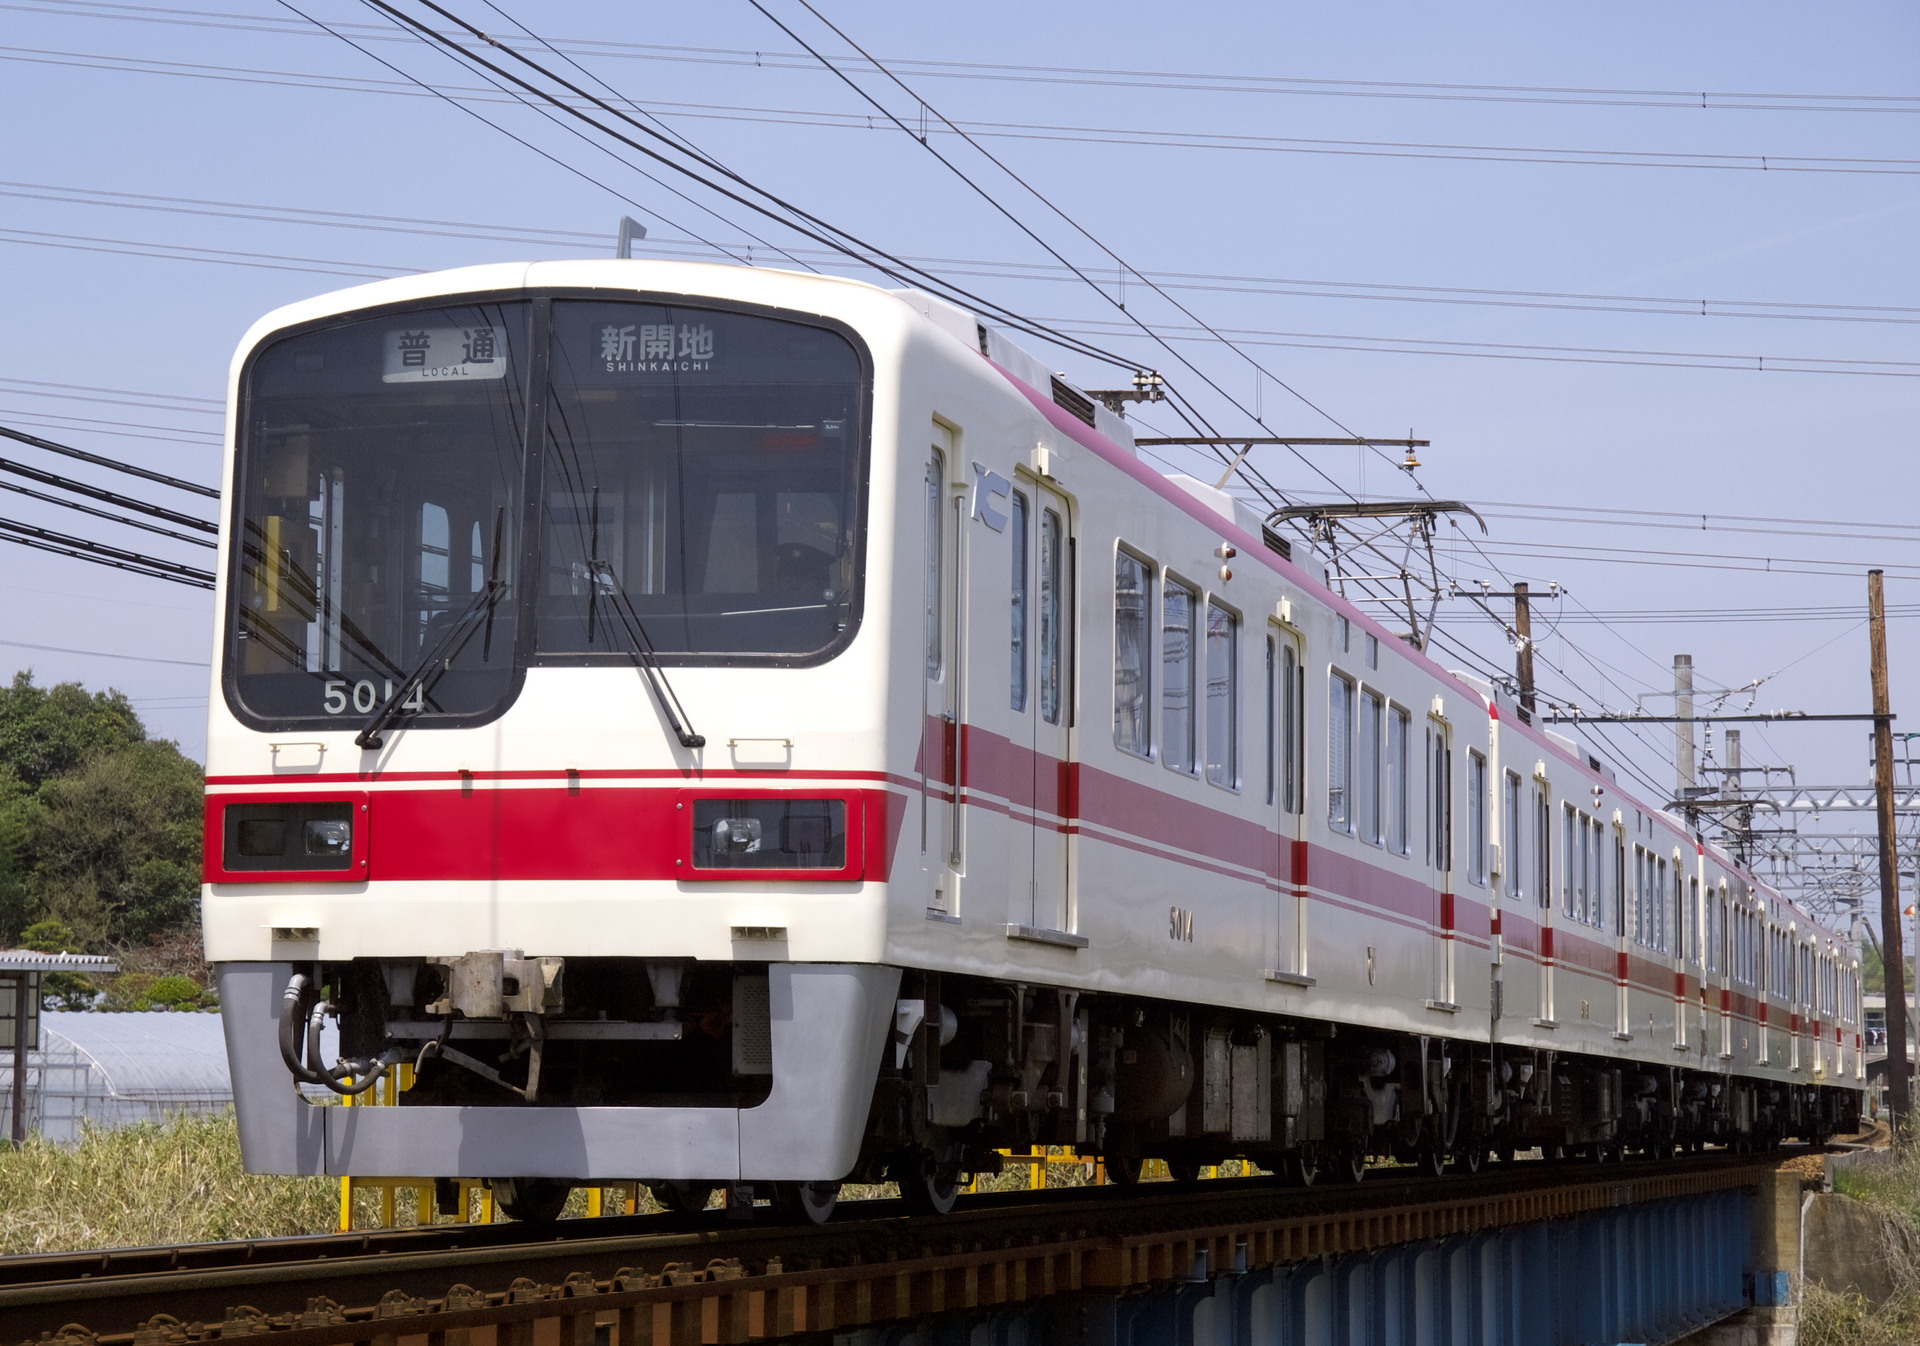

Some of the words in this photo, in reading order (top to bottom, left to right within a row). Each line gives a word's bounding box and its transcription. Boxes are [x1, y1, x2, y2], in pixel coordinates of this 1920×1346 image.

[398, 328, 495, 366] 普通
[600, 323, 714, 361] 新開地
[422, 367, 469, 377] LOCAL
[606, 361, 709, 372] SHINKAICHI
[323, 678, 425, 714] 5014
[1169, 905, 1194, 943] 5014
